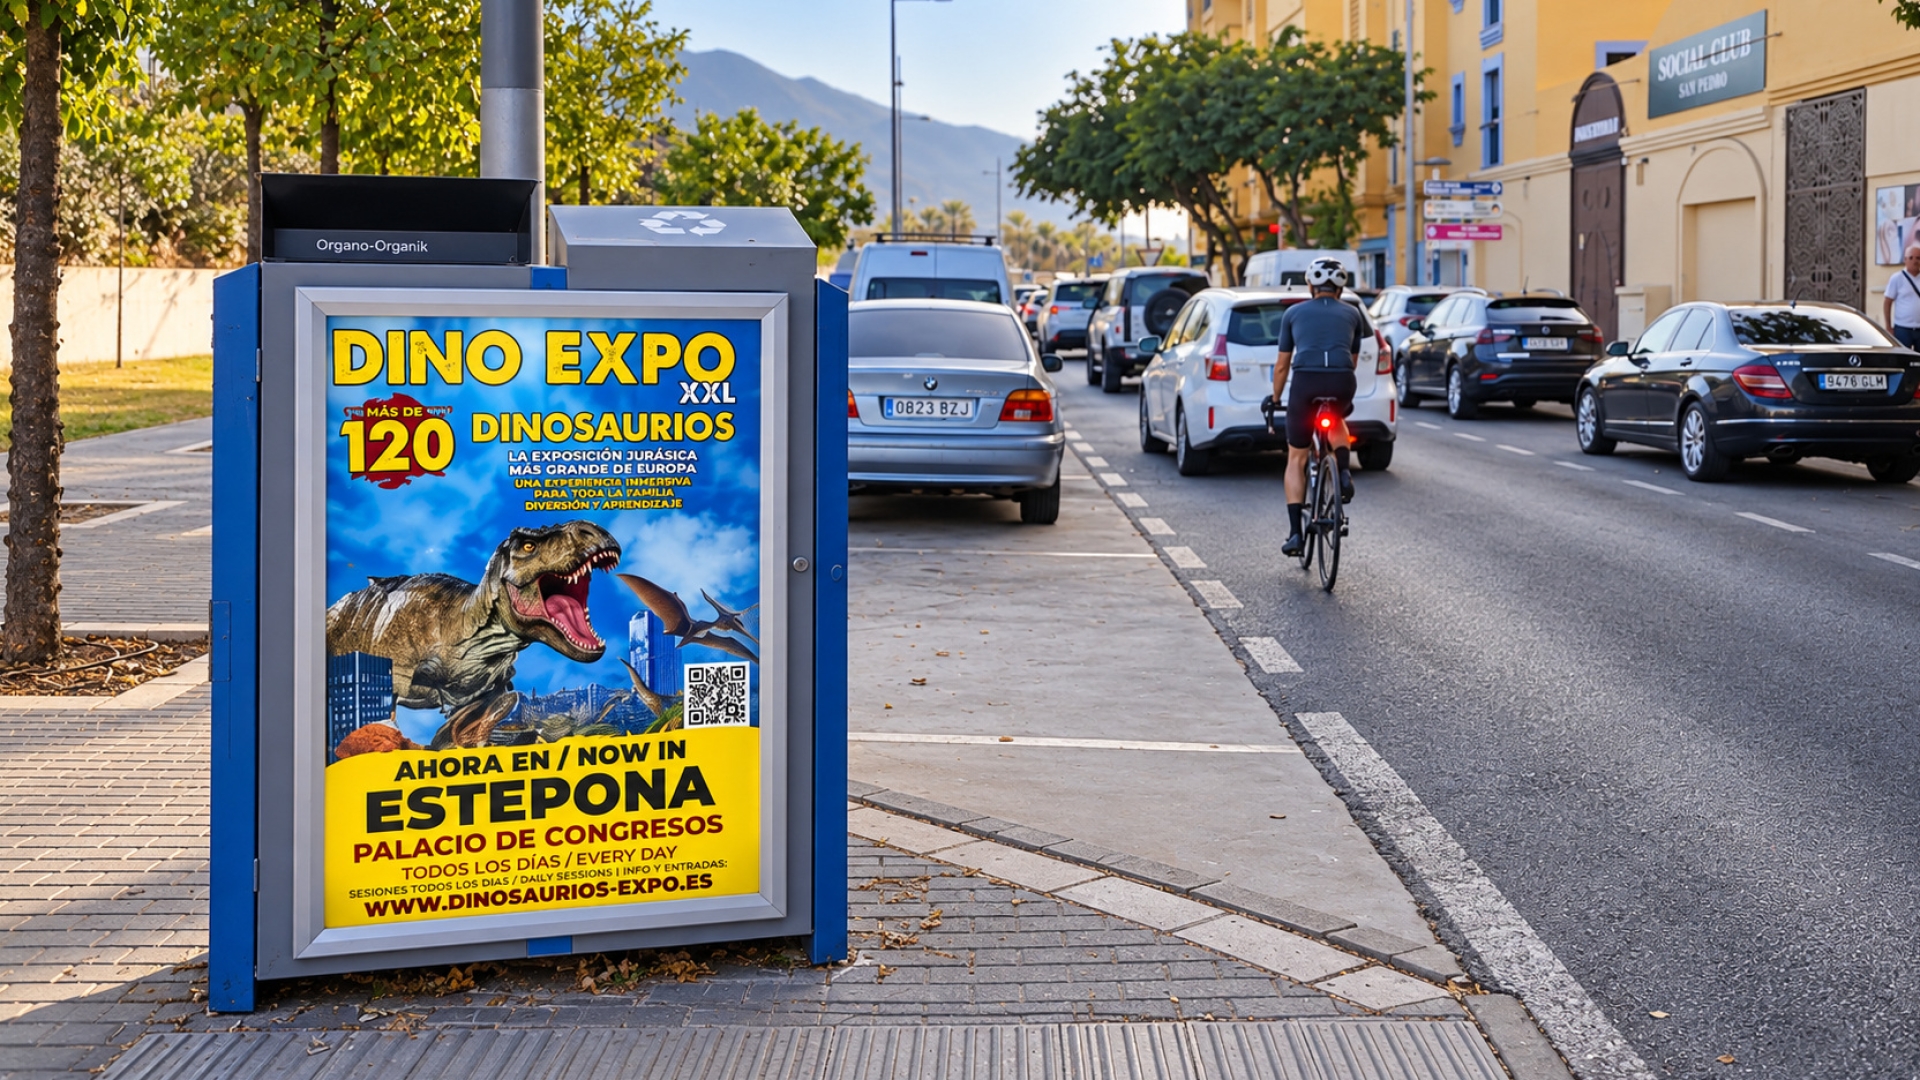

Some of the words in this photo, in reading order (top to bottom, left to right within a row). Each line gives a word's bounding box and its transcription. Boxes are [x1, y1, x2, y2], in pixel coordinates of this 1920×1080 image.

[1658, 44, 1707, 81] SOCIAL
[1711, 28, 1751, 66] CLUB
[1679, 80, 1696, 99] SAN
[1697, 70, 1728, 93] PEDRO
[316, 239, 428, 254] Organo-Organik
[333, 329, 523, 386] DINO
[546, 331, 736, 385] EXPO
[679, 381, 736, 404] XXL
[367, 405, 399, 417] MÁS
[403, 406, 423, 417] DE
[895, 401, 934, 415] 0823
[940, 401, 969, 415] BZJ
[471, 411, 736, 443] DINOSAURIOS
[340, 417, 456, 473] 120
[508, 450, 528, 462] LA
[532, 447, 622, 461] EXPOSICIÓN
[626, 447, 698, 461] JURÁSICA
[509, 462, 542, 476] MÁS
[546, 463, 609, 475] GRANDE
[613, 463, 632, 474] DE
[637, 463, 697, 474] EUROPA
[515, 478, 541, 488] UNA
[525, 499, 590, 511] DIVERSIÓN
[607, 488, 623, 498] LA
[394, 754, 504, 782] AHORA
[512, 750, 549, 772] EN
[578, 742, 650, 767] NOW
[658, 740, 686, 760] IN
[366, 765, 717, 834] ESTEPONA
[353, 832, 487, 864] PALACIO
[496, 828, 535, 851] DE
[545, 814, 723, 847] CONGRESOS
[401, 862, 469, 881] TODOS
[475, 859, 511, 875] LOS
[517, 853, 561, 871] DÍAS
[577, 848, 636, 867] EVERY
[641, 845, 678, 861] DAY
[349, 886, 408, 899] SESIONES
[411, 881, 452, 894] TODOS
[456, 879, 479, 890] LOS
[520, 872, 554, 885] DAILY
[556, 868, 613, 881] SESSIONS
[623, 863, 651, 876] INFO
[653, 863, 662, 873] Y
[364, 873, 714, 918] WWW.DINOSAURIOS-EXPO.ES
